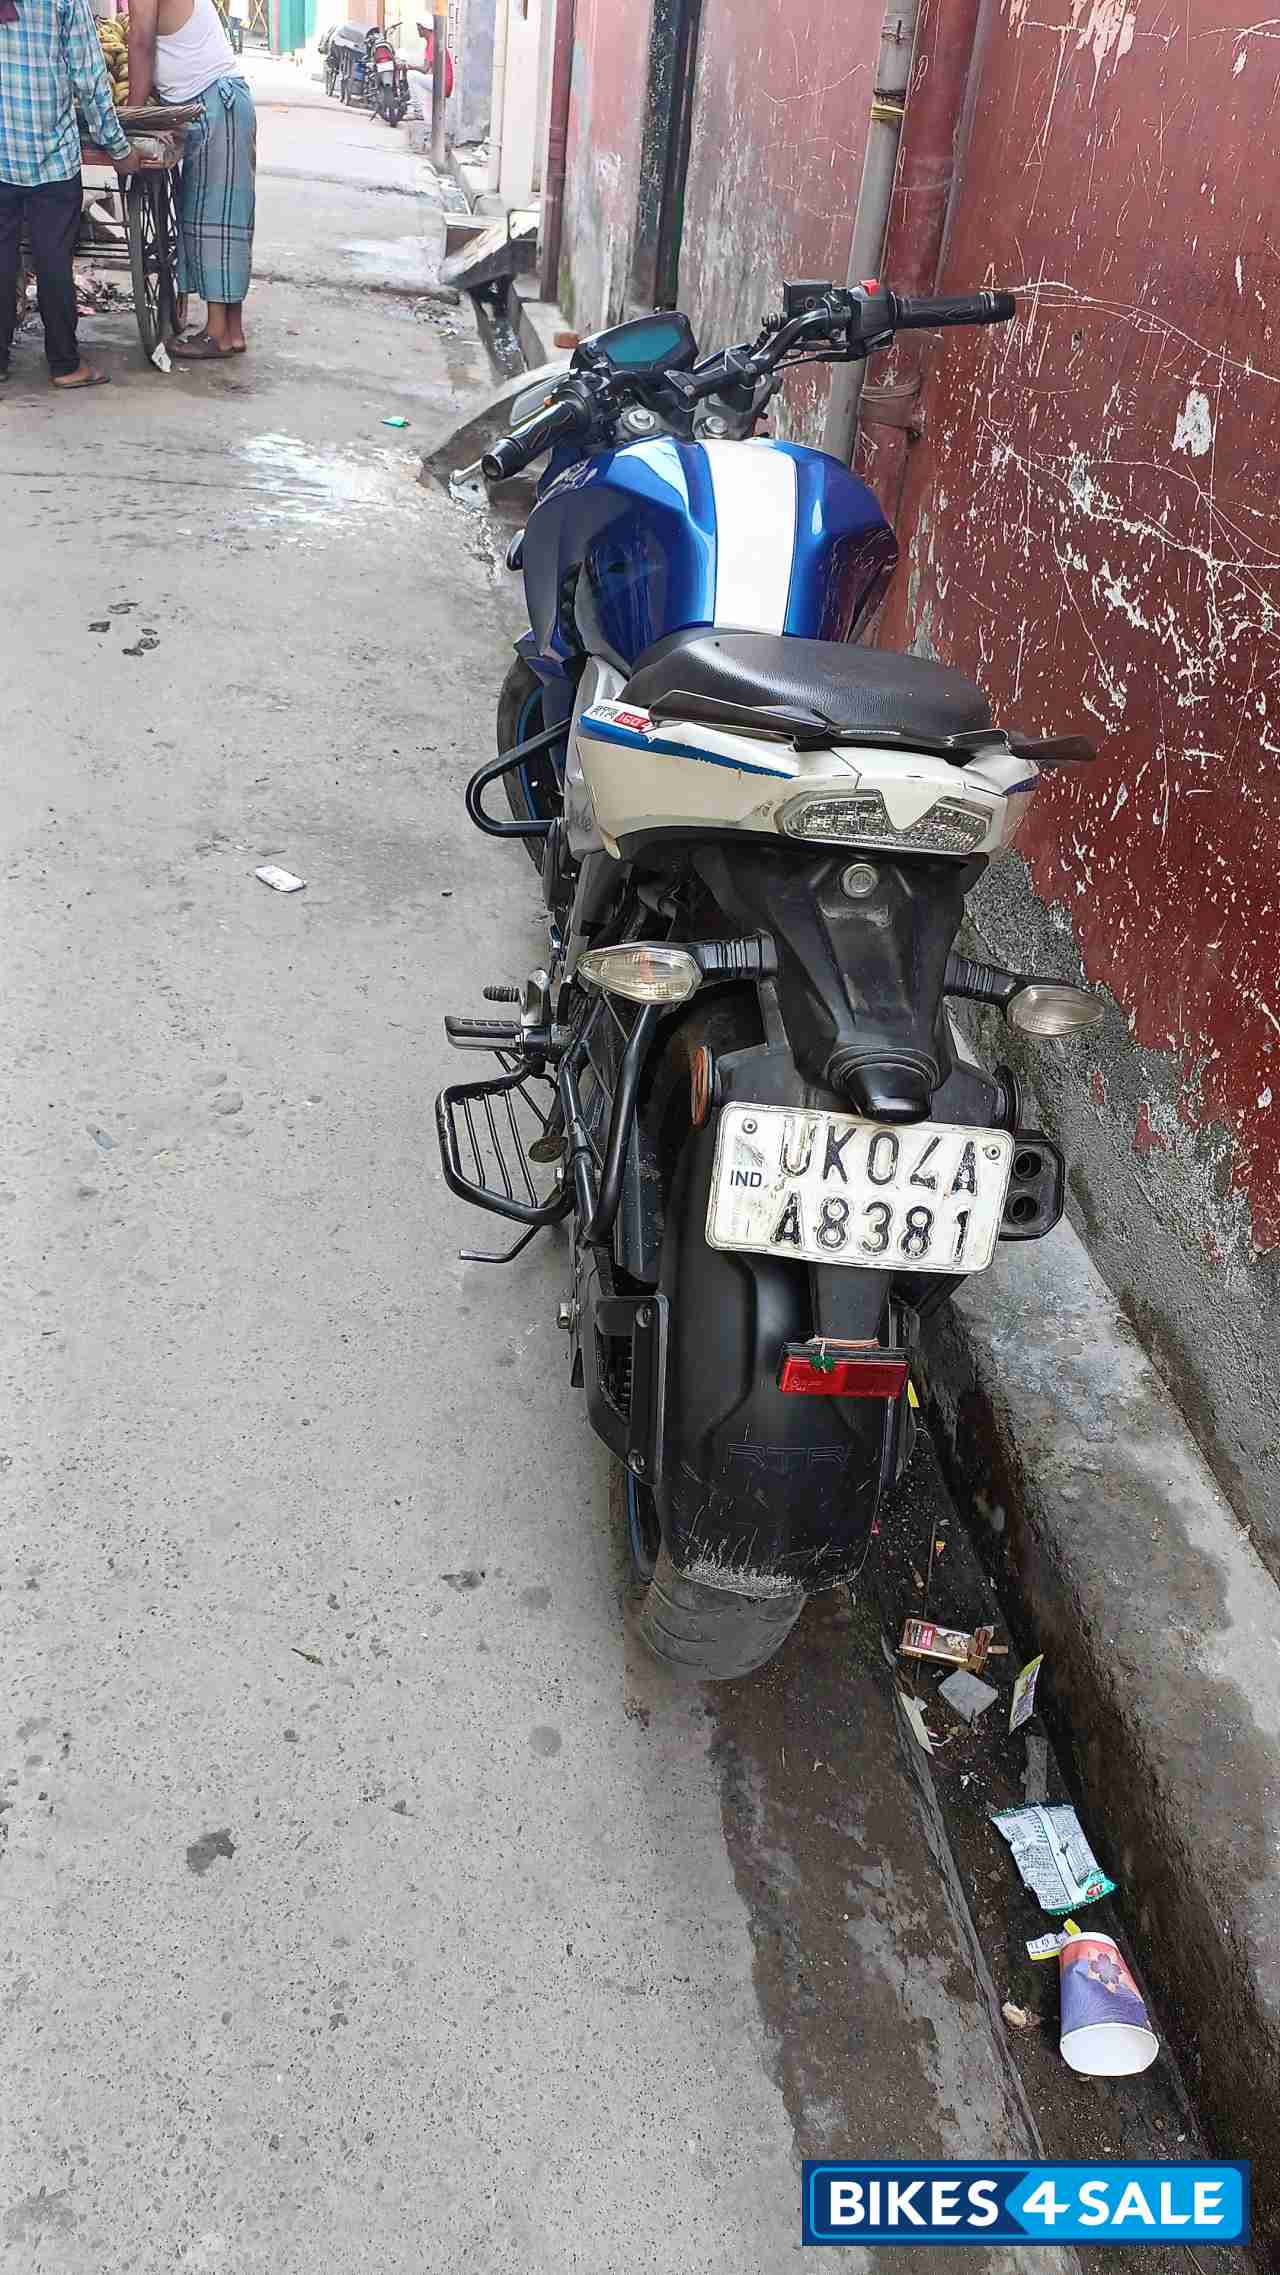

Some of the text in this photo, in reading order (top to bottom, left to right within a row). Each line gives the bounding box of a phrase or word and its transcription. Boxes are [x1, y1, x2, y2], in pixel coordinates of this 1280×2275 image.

[730, 1169, 762, 1188] IND
[779, 1117, 978, 1196] UK04A
[770, 1191, 971, 1264] A8381
